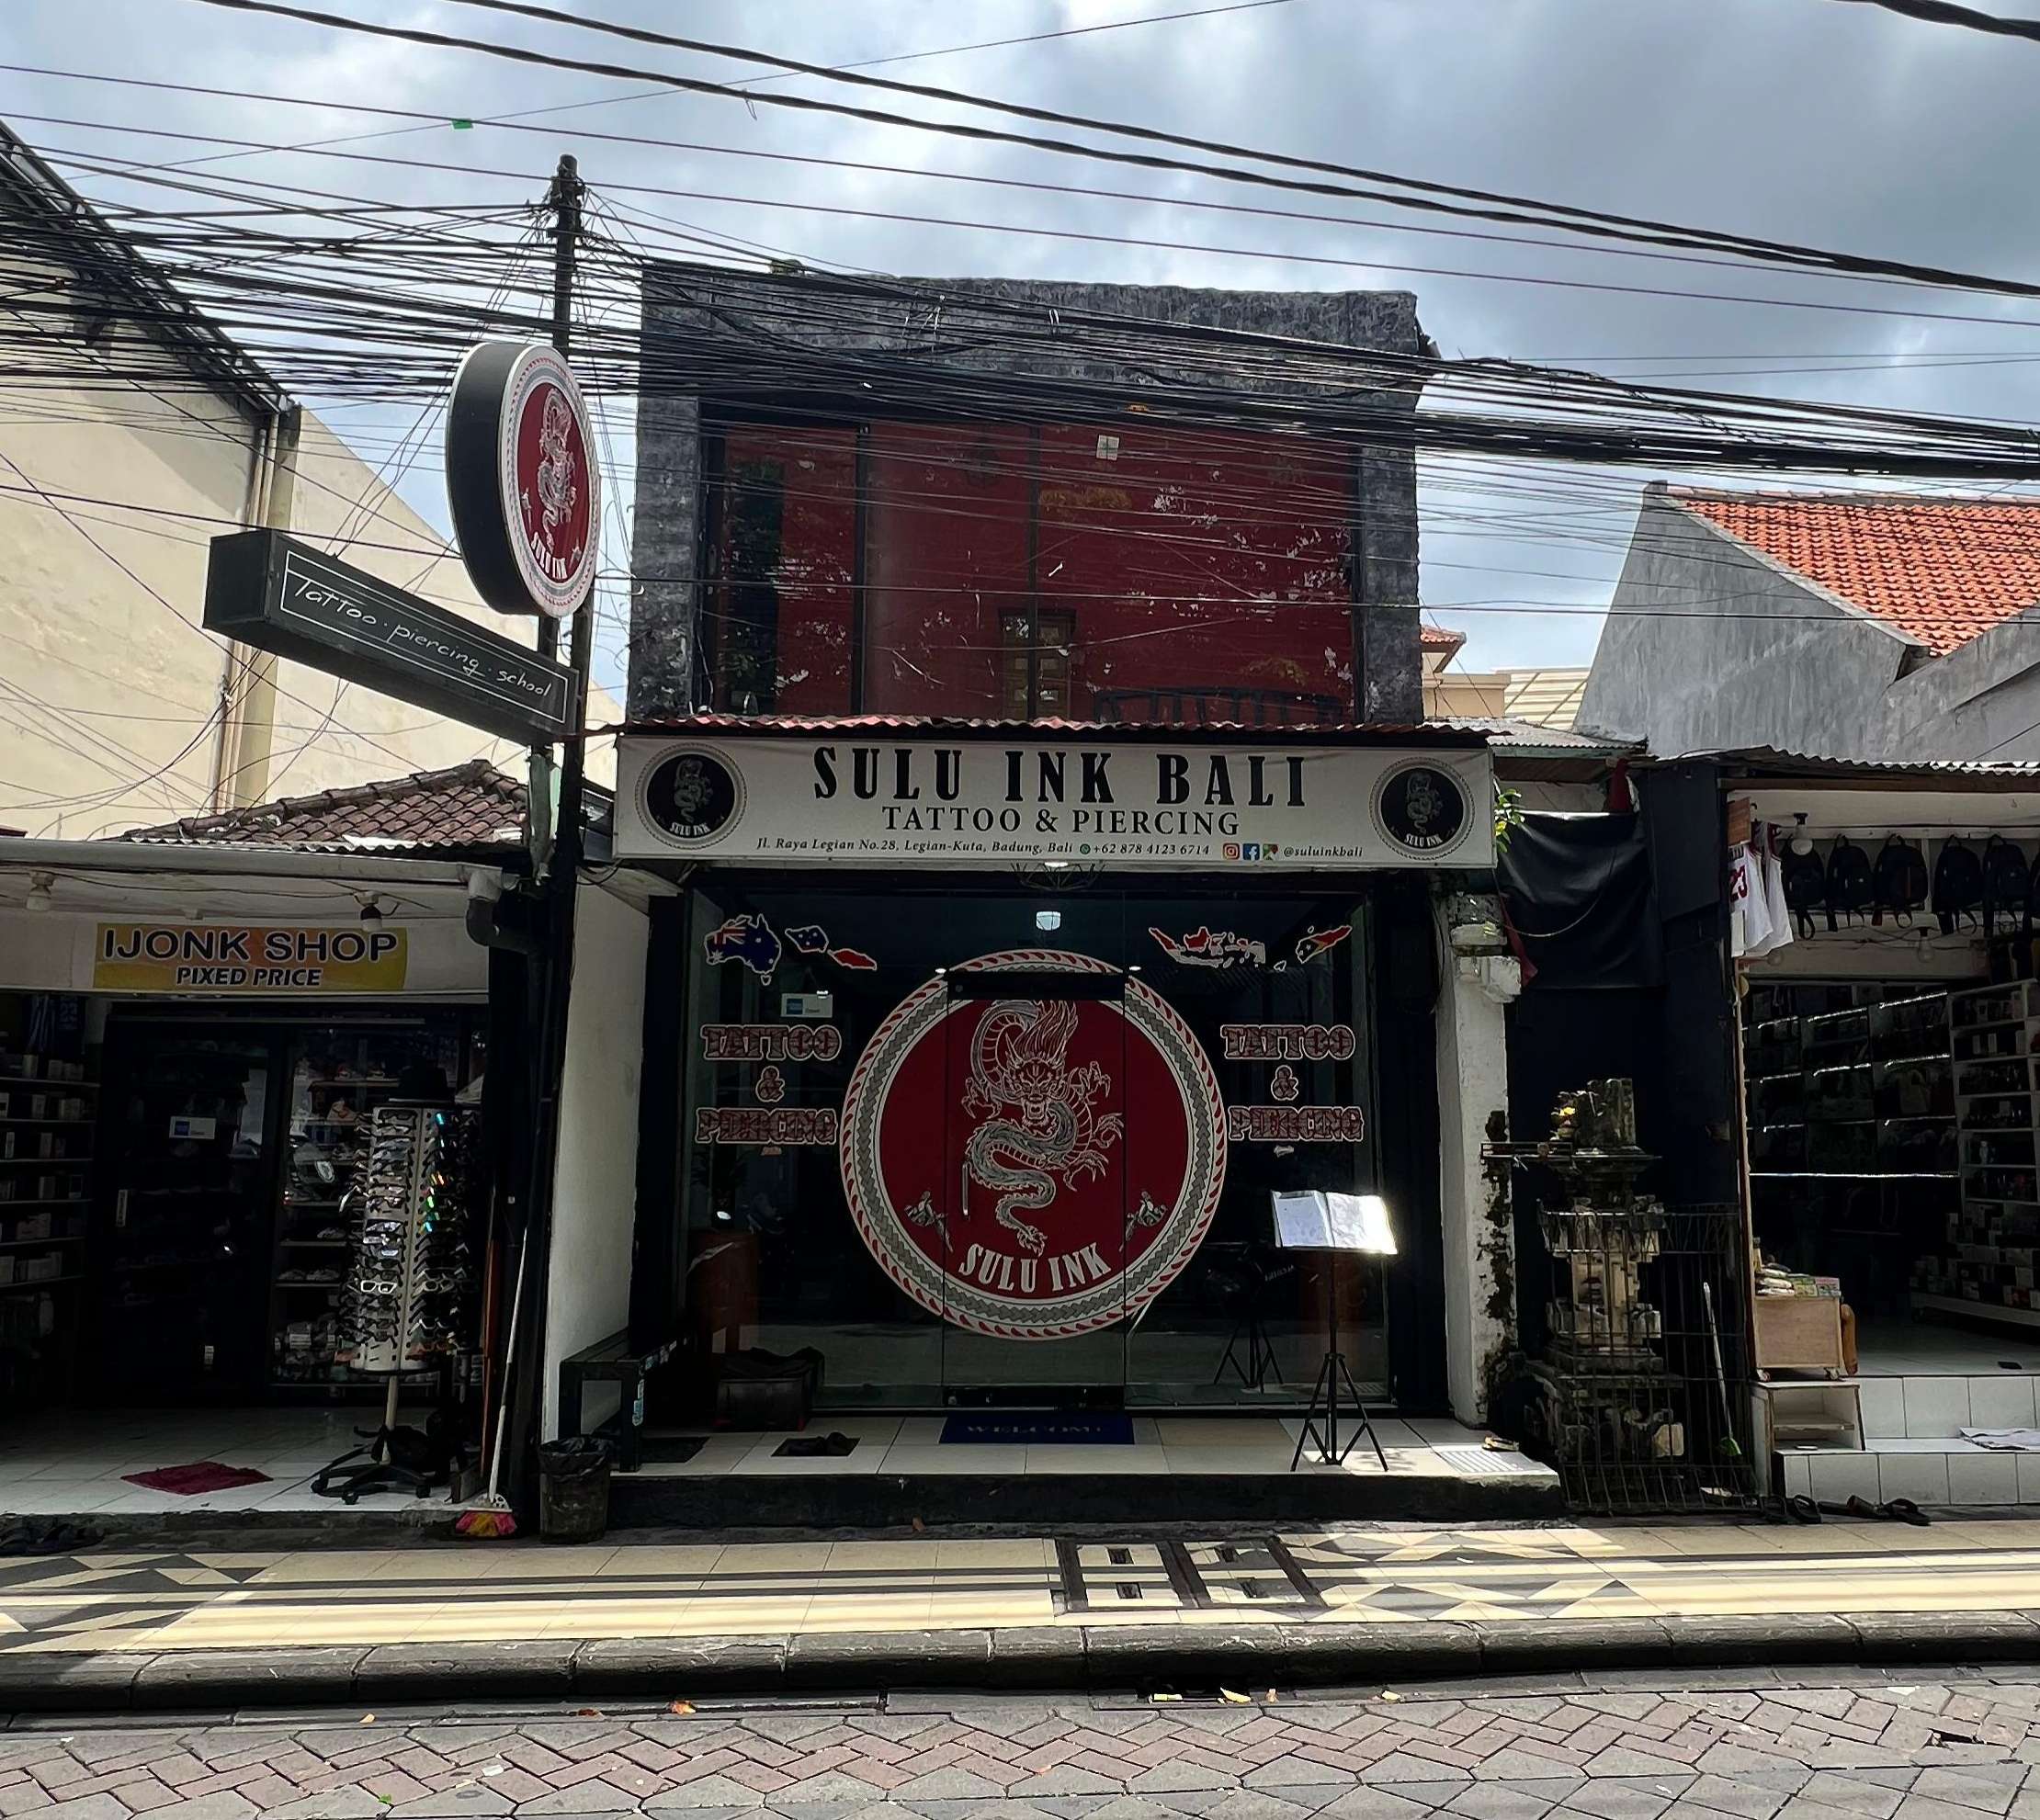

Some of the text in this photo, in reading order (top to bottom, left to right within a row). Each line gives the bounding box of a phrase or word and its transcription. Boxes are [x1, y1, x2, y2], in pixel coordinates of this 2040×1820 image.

[386, 624, 485, 677] piercing
[496, 670, 551, 696] school
[813, 746, 1307, 808] SULU INK BALI
[881, 806, 1240, 836] TATTOO & PIERCING
[776, 838, 808, 852] Raya
[811, 838, 855, 853] Legian
[858, 840, 900, 852] No.28,
[904, 840, 987, 853] Legian-Kuta,
[992, 841, 1043, 855] Badung,
[1048, 842, 1073, 853] Bali
[1093, 843, 1116, 855] +62
[1120, 843, 1142, 854] 878
[1146, 843, 1176, 855] 4123
[1180, 844, 1210, 856] 6714
[1283, 845, 1364, 858] @suluinkbali
[104, 928, 398, 962] IJONK SHOP
[176, 967, 323, 987] PIXED PRICE
[700, 1024, 843, 1060] TATTOO
[1219, 1024, 1356, 1060] TATTOO
[755, 1065, 785, 1102] &
[1270, 1065, 1299, 1101] &
[695, 1107, 838, 1145] PIERCING
[1228, 1105, 1364, 1142] PIERCING
[958, 1242, 1113, 1293] SULU INK
